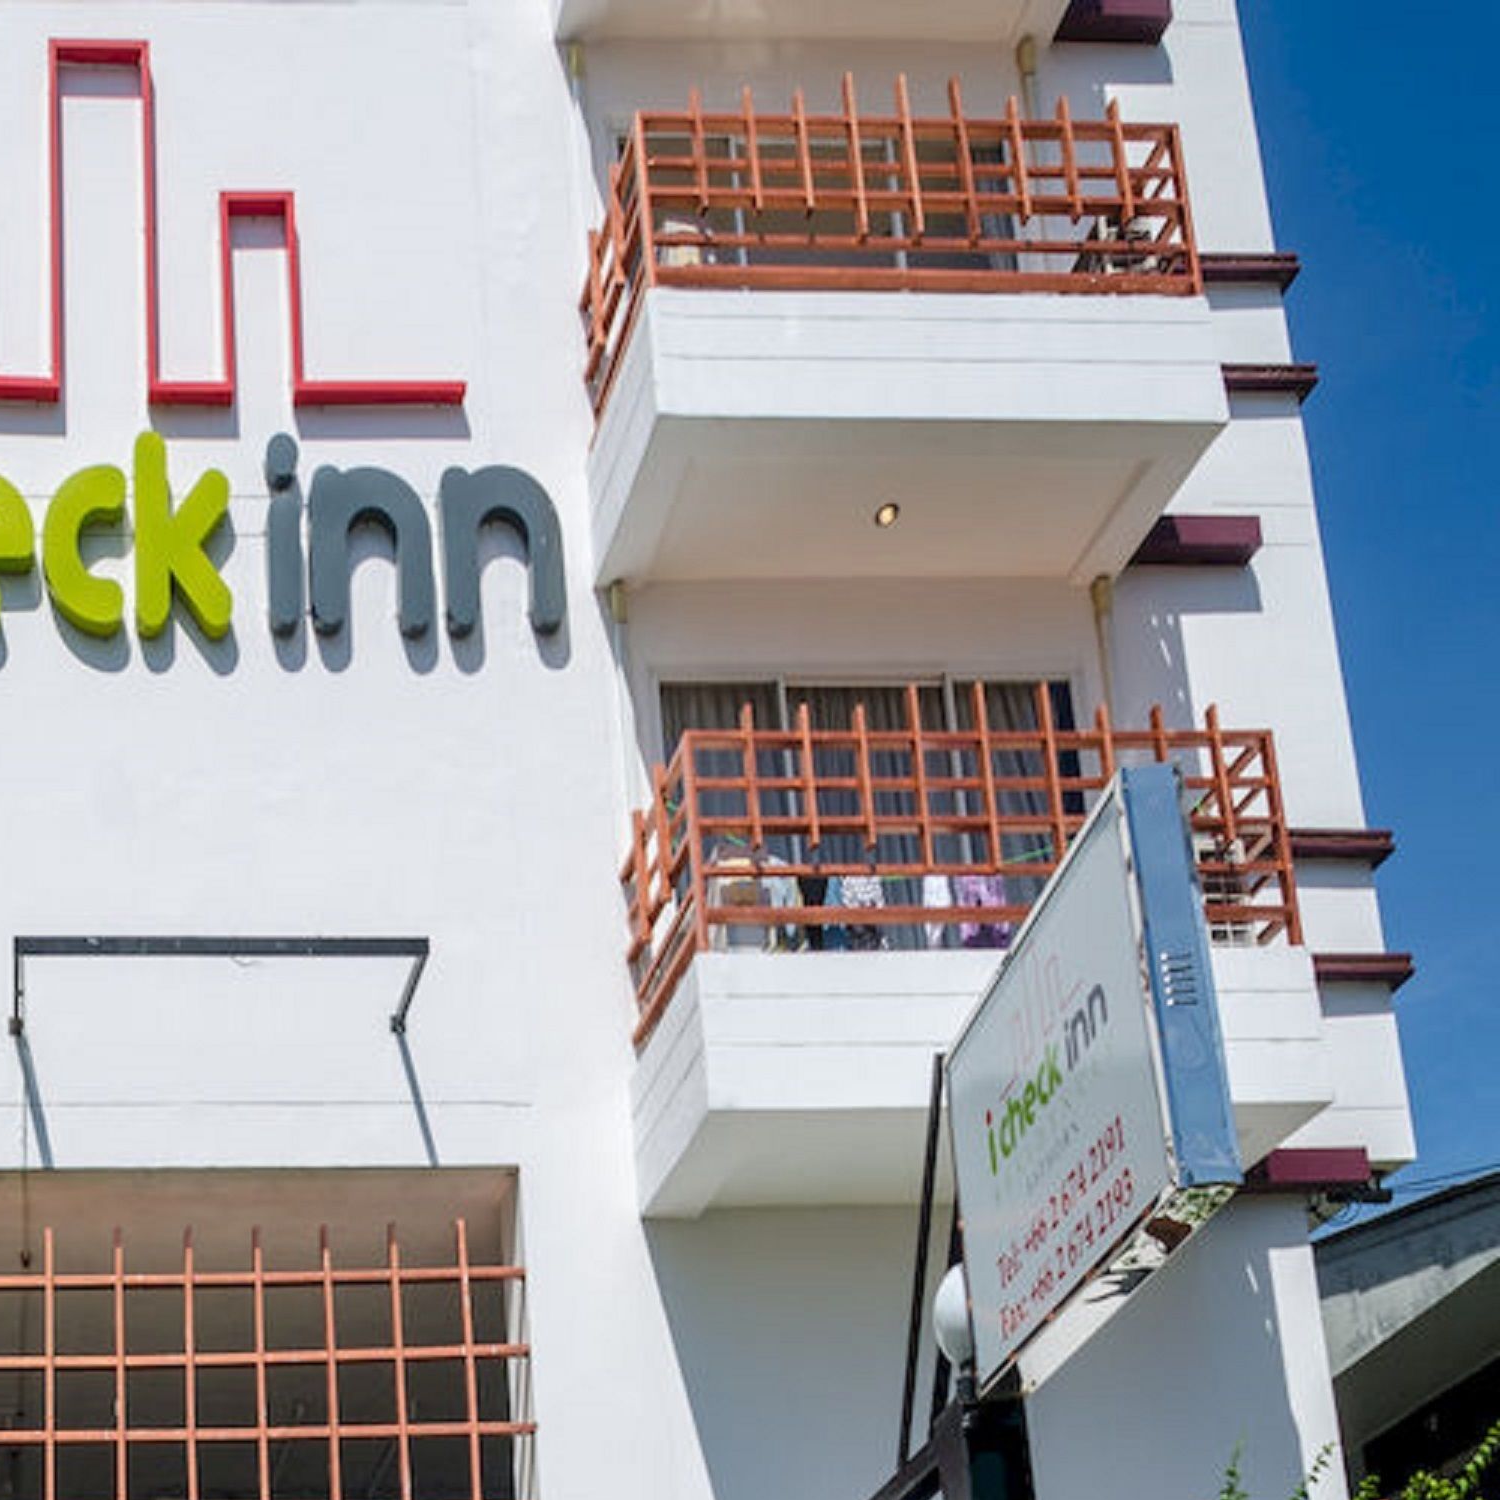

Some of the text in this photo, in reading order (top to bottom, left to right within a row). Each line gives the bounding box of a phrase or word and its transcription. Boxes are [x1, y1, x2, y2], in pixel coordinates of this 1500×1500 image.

[266, 432, 566, 639] inn
[1064, 983, 1108, 1072] inn
[1088, 1114, 1125, 1184] 2191
